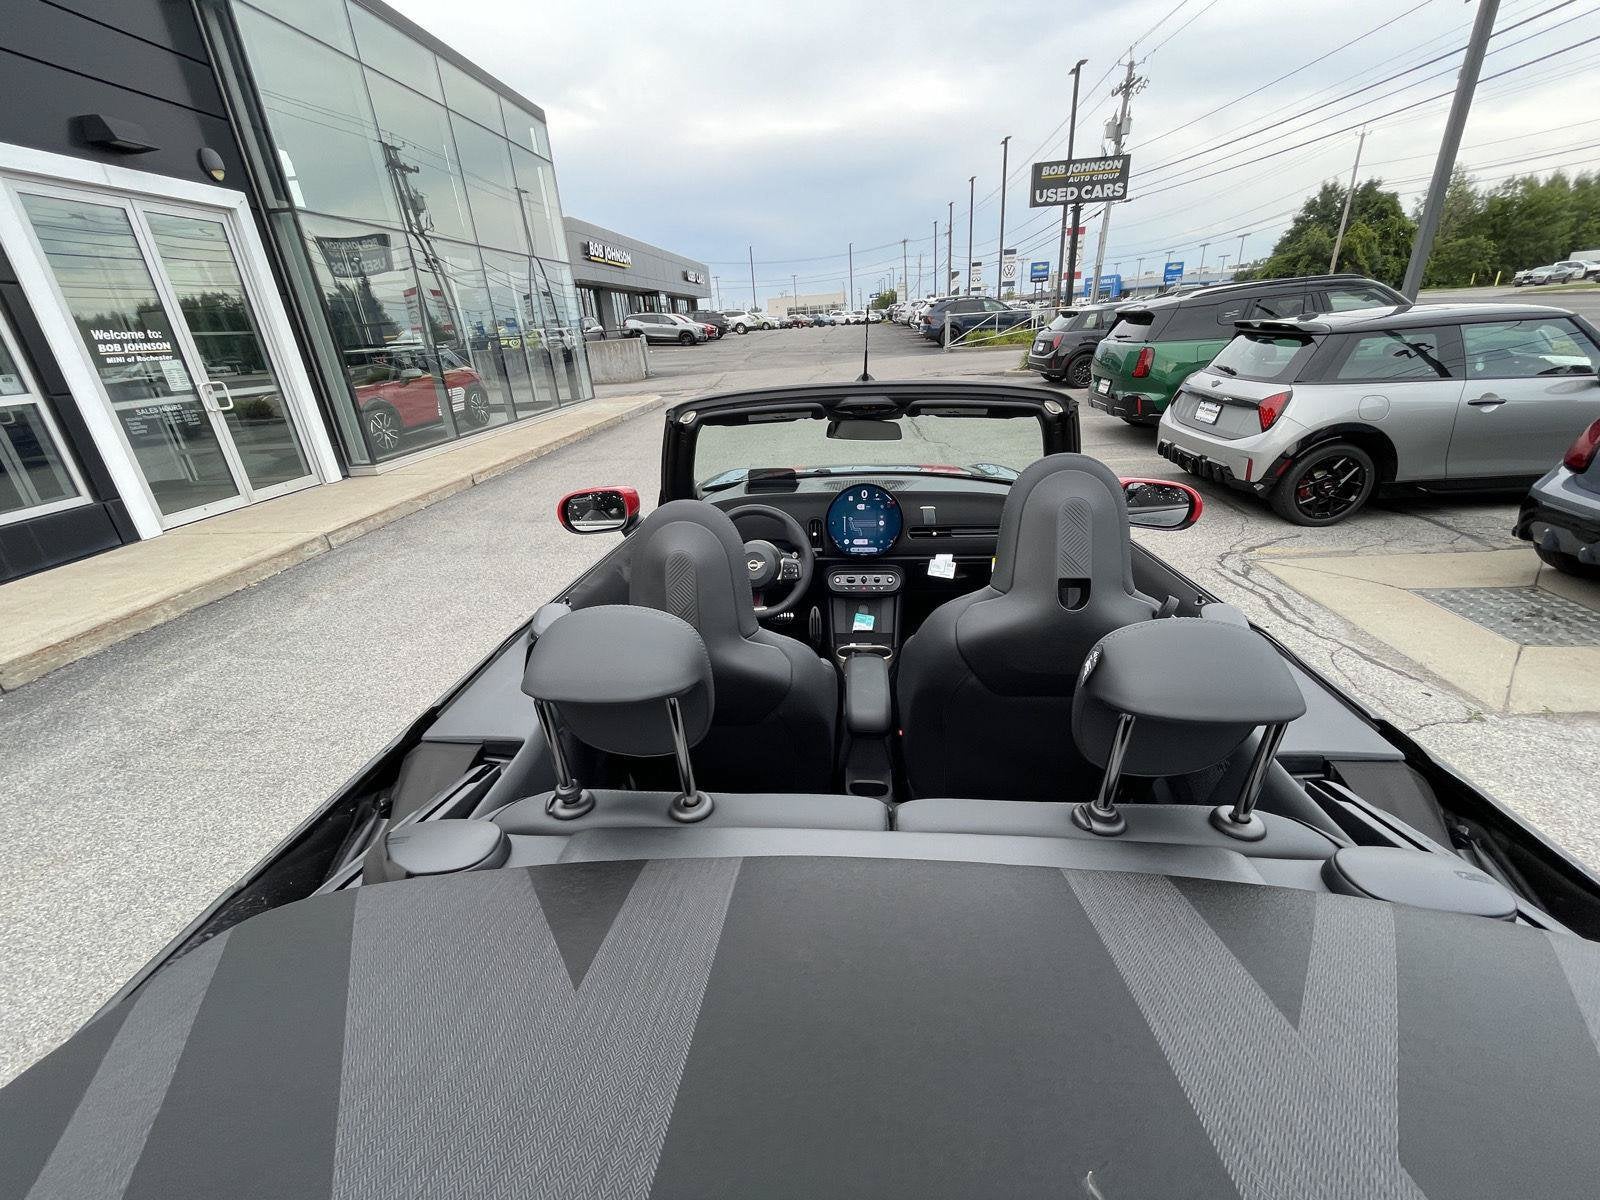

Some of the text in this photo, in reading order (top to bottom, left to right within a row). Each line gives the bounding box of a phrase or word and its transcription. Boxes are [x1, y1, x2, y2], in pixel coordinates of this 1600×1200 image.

[1041, 159, 1123, 176] BOB JOHNSON
[1092, 173, 1120, 181] GROUP
[1035, 182, 1124, 202] USED CARS
[589, 240, 632, 265] BOB JOHNSON
[90, 329, 163, 340] Welcome to:
[98, 342, 172, 353] BOB JOHNSON
[106, 354, 173, 364] MINI of Rochester
[136, 407, 159, 416] SALES
[160, 403, 183, 412] HOURS
